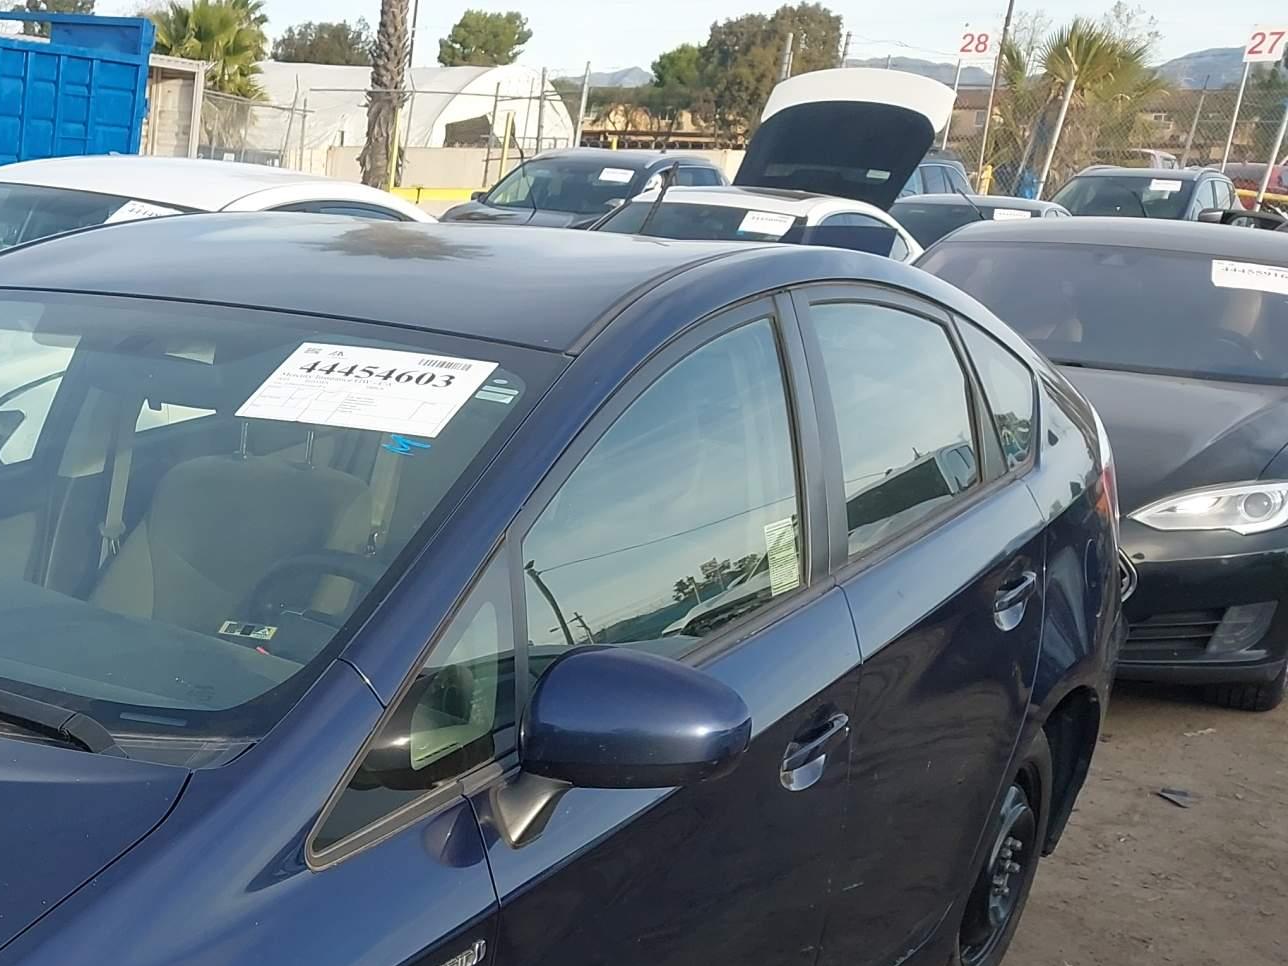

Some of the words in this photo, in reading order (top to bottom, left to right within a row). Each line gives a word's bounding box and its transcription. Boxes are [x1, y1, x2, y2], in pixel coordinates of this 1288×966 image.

[959, 33, 989, 53] 28
[1247, 31, 1286, 55] 27
[298, 360, 456, 388] 44454603
